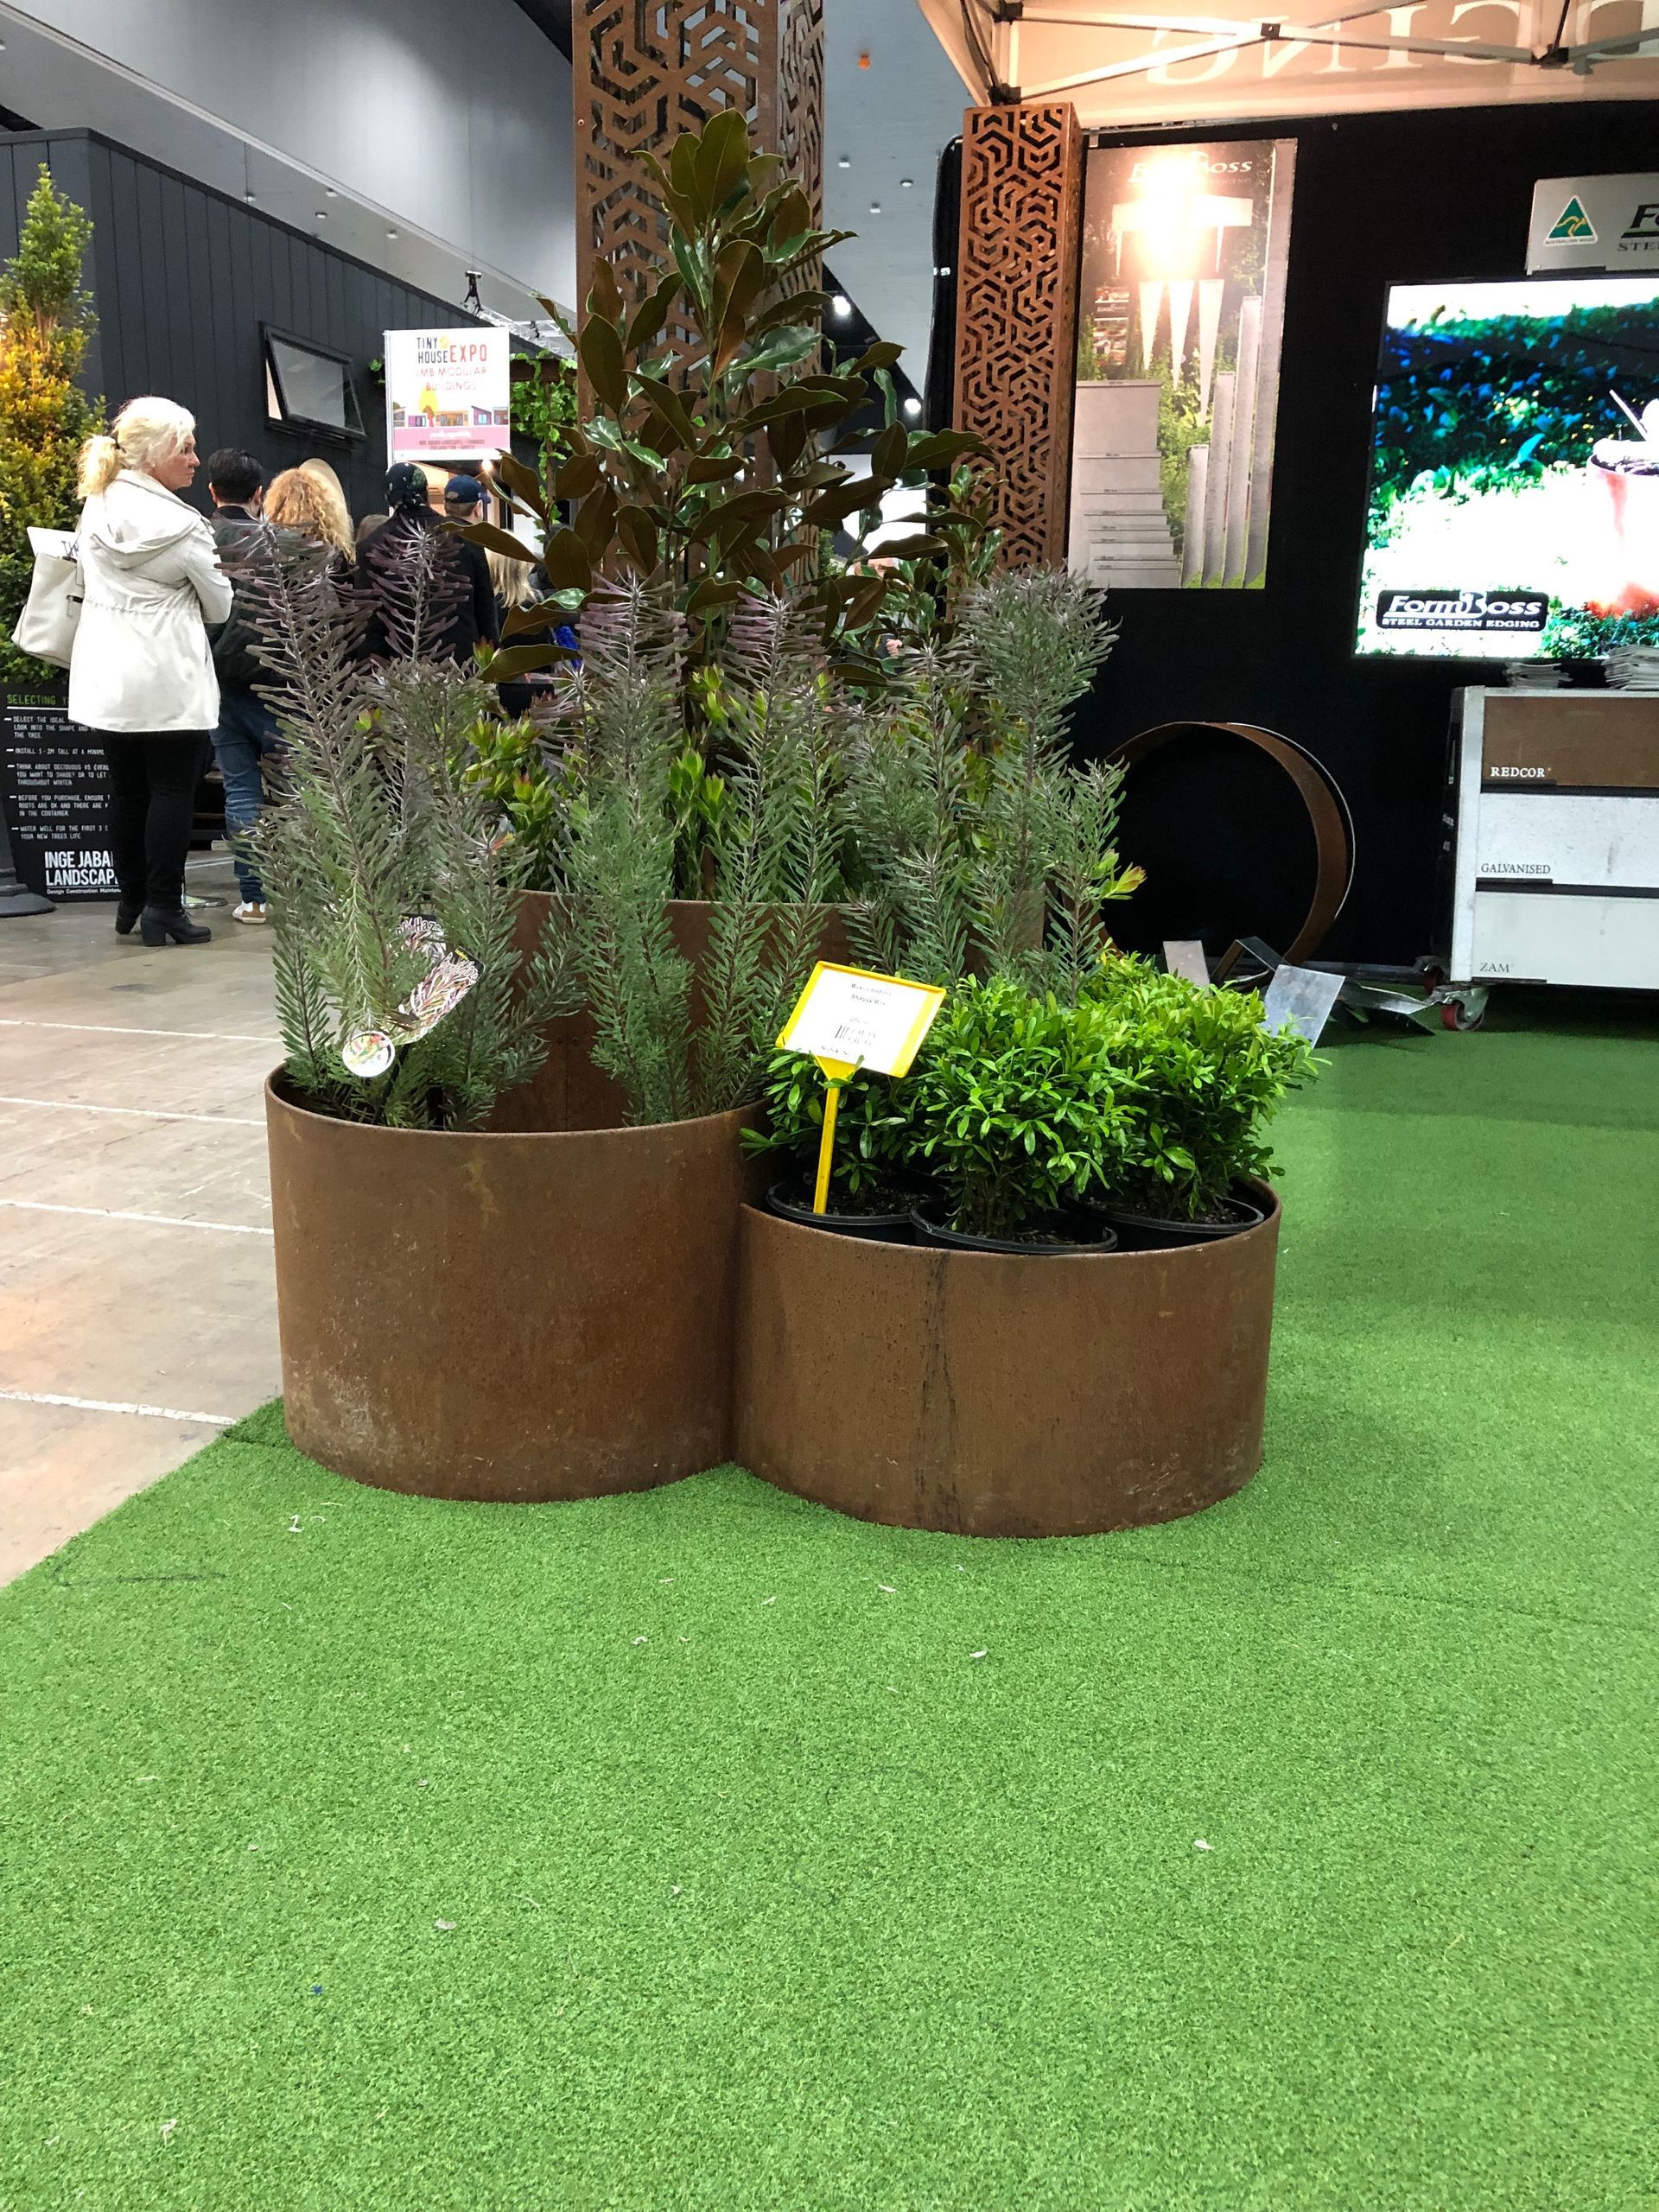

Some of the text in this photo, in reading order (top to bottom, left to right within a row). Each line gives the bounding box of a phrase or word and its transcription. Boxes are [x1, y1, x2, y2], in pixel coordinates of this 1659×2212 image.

[416, 337, 437, 349] TINY
[418, 344, 487, 364] HOUSE EXPO
[1383, 590, 1542, 618] FormBoss
[1486, 620, 1540, 628] EDGING
[7, 694, 56, 705] SELECTING
[1490, 766, 1546, 778] REDCOR
[44, 851, 114, 868] INGE JABA
[1480, 864, 1551, 874] GALVANISED
[45, 869, 118, 886] LANDSCAP
[1479, 963, 1510, 973] ZAM
